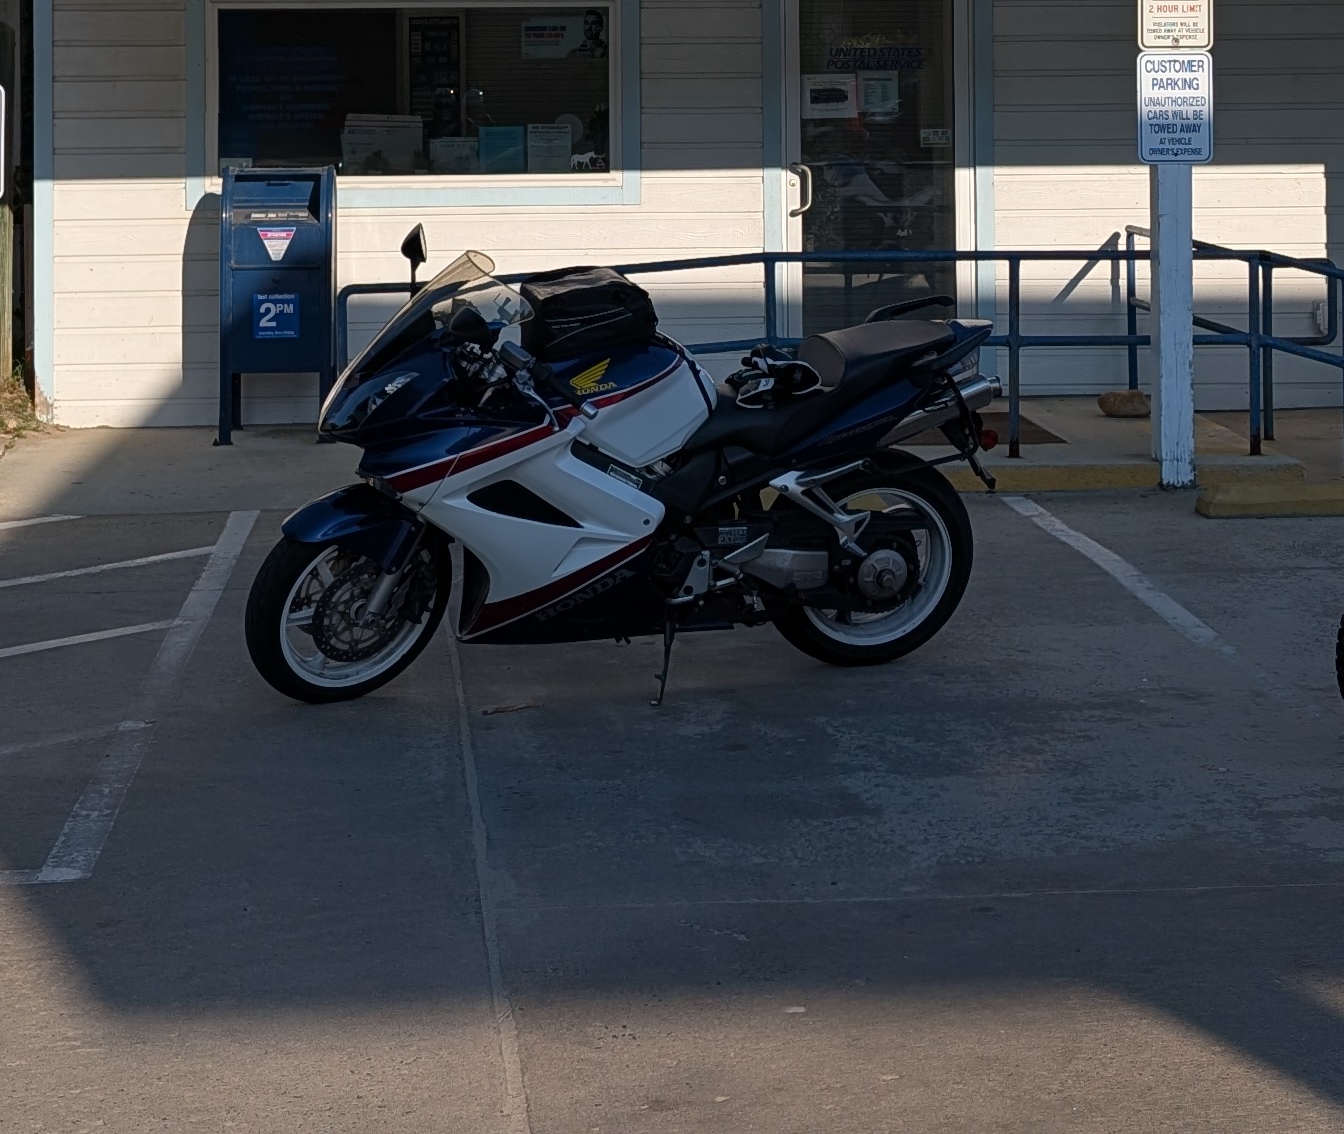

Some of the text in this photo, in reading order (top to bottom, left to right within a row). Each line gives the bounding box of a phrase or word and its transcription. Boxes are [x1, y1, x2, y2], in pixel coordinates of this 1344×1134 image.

[1149, 4, 1202, 13] 2 HOUR LIMIT
[829, 48, 923, 57] UNITED STATES
[827, 60, 925, 69] POSTAL SERVICE
[1145, 60, 1204, 73] CUSTOMER
[1152, 77, 1199, 91] PARKING
[1144, 96, 1206, 106] UNAUTHORIZED
[1147, 110, 1203, 120] CARS WILL BE
[1149, 123, 1201, 134] TOWED AWAY
[1159, 137, 1192, 145] AT VEHICLE
[536, 569, 636, 622] HONDA
